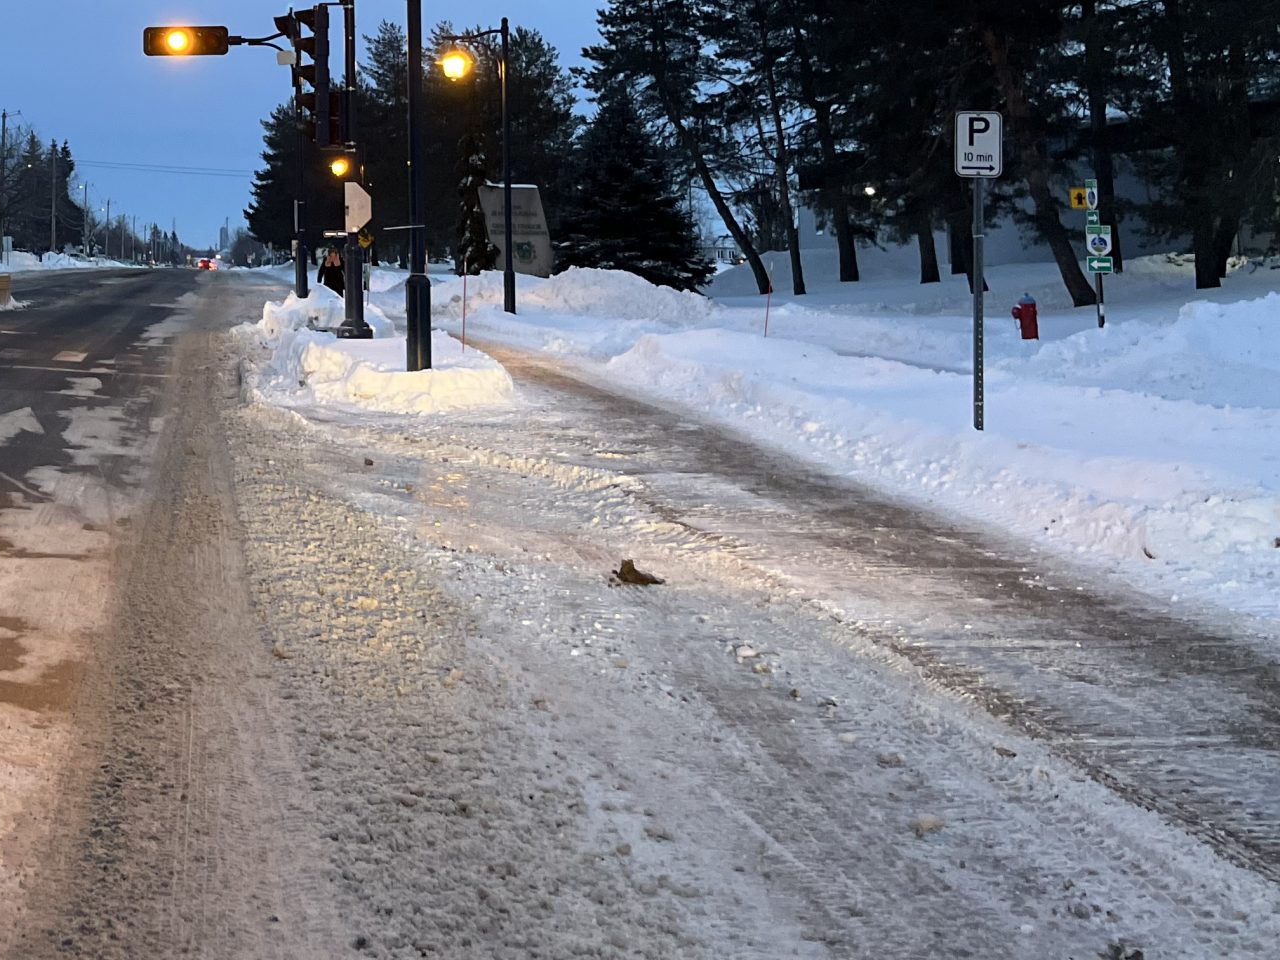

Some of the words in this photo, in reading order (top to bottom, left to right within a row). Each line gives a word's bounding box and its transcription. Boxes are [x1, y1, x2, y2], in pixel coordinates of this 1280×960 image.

[968, 117, 990, 146] P
[964, 152, 974, 162] 10
[976, 153, 993, 162] min
